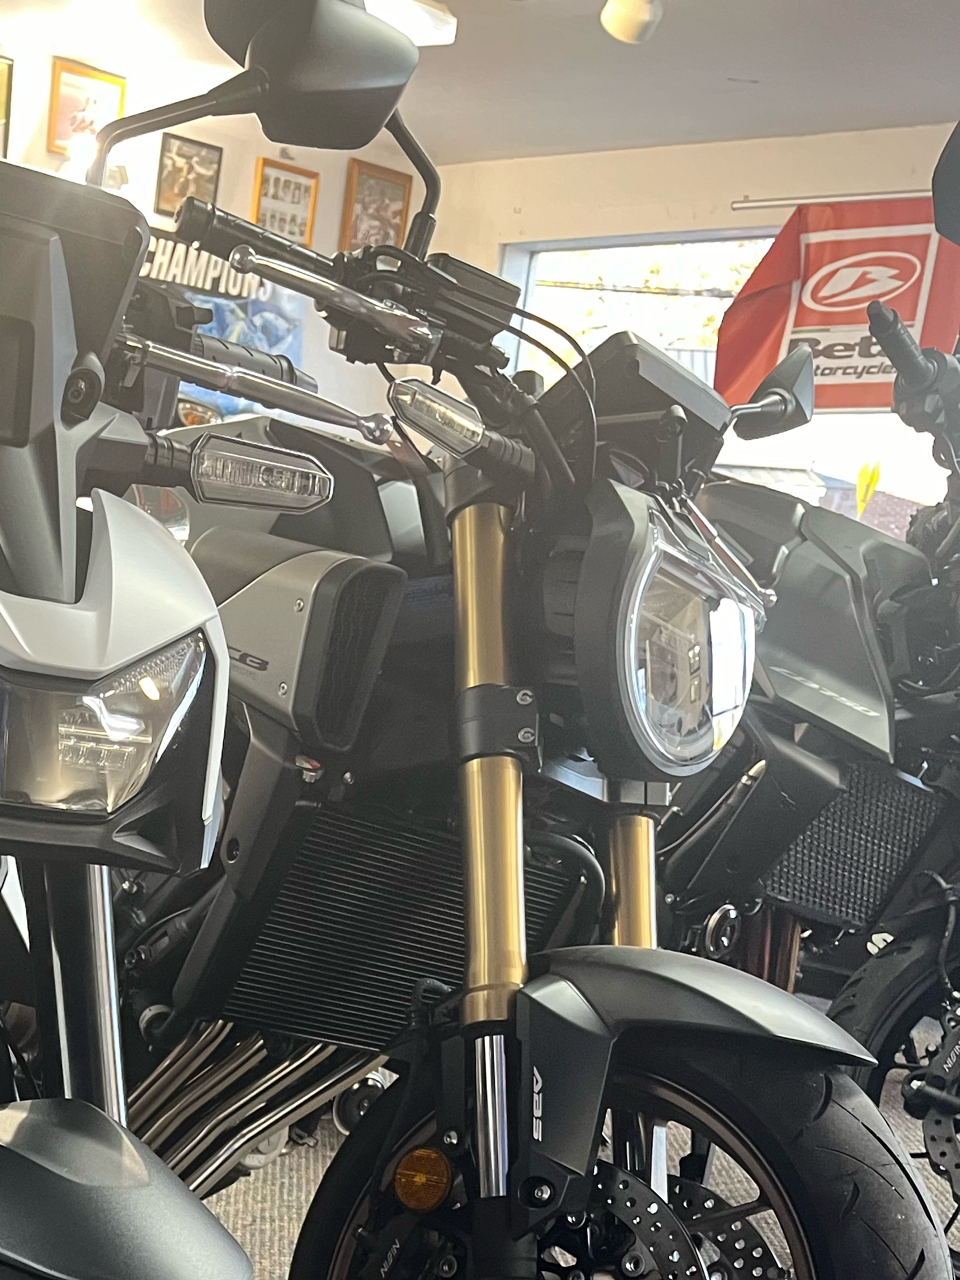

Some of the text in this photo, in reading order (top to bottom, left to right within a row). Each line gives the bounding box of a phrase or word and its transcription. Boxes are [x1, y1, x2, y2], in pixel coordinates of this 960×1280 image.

[789, 335, 887, 359] Bet
[813, 362, 897, 379] torcycle
[533, 1065, 543, 1142] ABS
